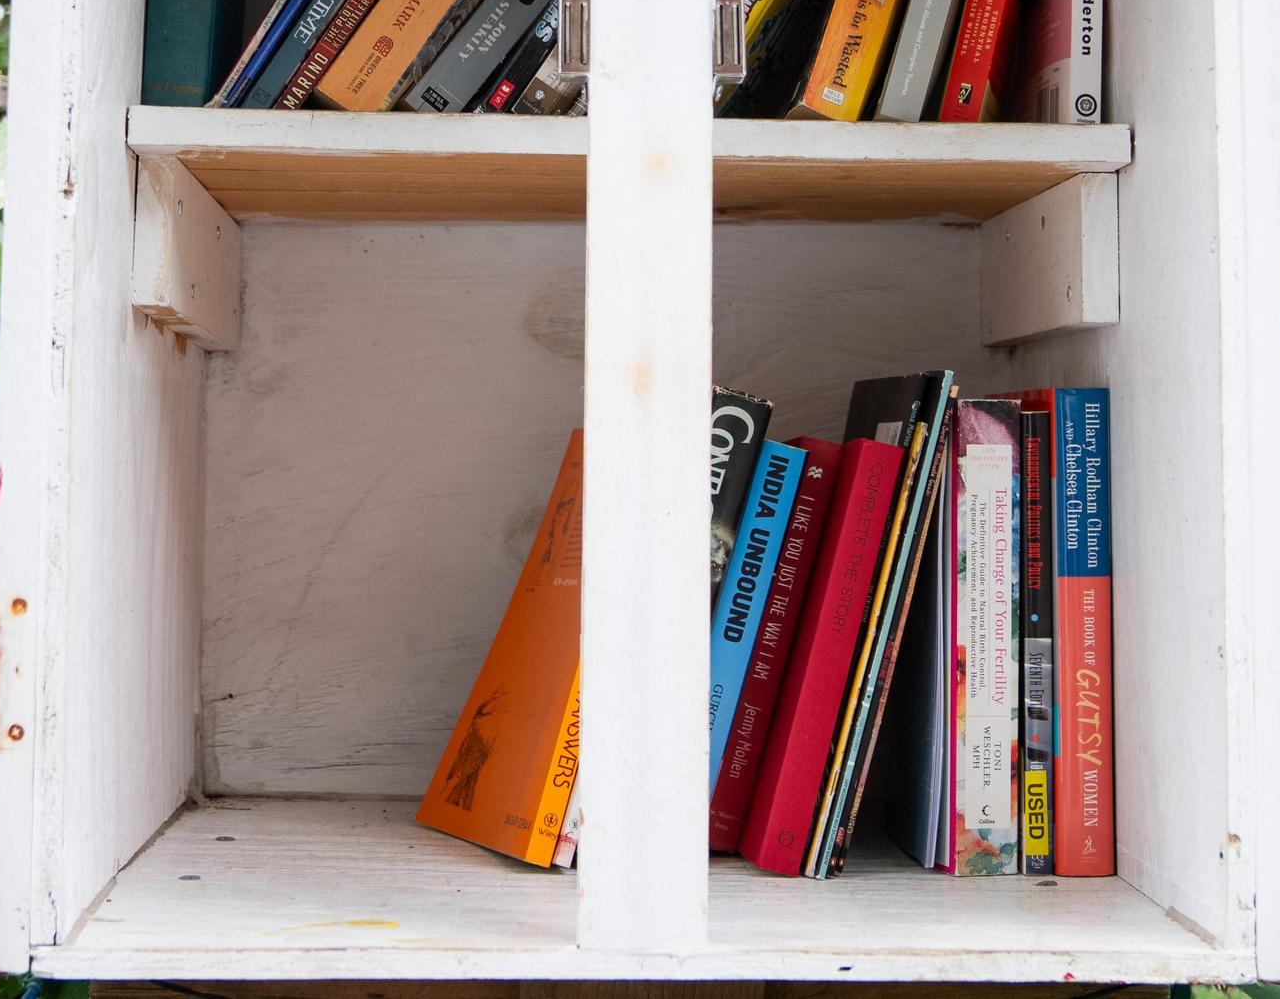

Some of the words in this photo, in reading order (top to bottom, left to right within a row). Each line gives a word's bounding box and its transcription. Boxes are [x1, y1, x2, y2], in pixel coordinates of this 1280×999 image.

[325, 28, 340, 43] THE
[336, 7, 355, 29] PLOT
[459, 0, 509, 63] STEAKLEY
[850, 11, 868, 28] for
[985, 10, 998, 50] THOMAS
[332, 28, 347, 48] KILL
[478, 20, 507, 54] JOHN
[961, 22, 973, 55] WIESEL
[366, 56, 382, 77] BEECH
[832, 34, 864, 88] Wasted
[283, 52, 329, 110] MARINO
[352, 75, 368, 96] TREE
[909, 400, 921, 424] Gianna
[1084, 402, 1101, 453] Hillary
[903, 424, 915, 447] Marino
[1065, 421, 1074, 440] AND
[755, 454, 789, 518] INDIA
[1065, 443, 1082, 497] Chelsea
[1085, 456, 1101, 515] Rodham
[792, 505, 813, 532] LIKE
[853, 463, 883, 547] COMPLETE
[970, 494, 978, 536] Pregnancy
[979, 503, 987, 514] The
[993, 488, 1008, 532] Taking
[979, 516, 987, 559] Definitive
[1067, 499, 1083, 550] Clinton
[784, 534, 804, 561] YOU
[1087, 518, 1102, 568] Clinton
[777, 563, 797, 591] JUST
[844, 554, 863, 582] THE
[979, 562, 987, 587] Guide
[993, 537, 1008, 586] Charge
[723, 528, 770, 643] UNBOUND
[980, 589, 986, 598] to
[995, 590, 1008, 605] of
[1083, 589, 1095, 612] THE
[769, 595, 789, 618] THE
[833, 587, 855, 636] STORY
[979, 600, 987, 631] Natural
[762, 622, 783, 649] WAY
[970, 615, 978, 664] Reproductive
[994, 607, 1008, 642] Your
[1083, 615, 1096, 646] BOOK
[753, 660, 771, 680] AM
[1083, 650, 1096, 666] OF
[992, 647, 1007, 705] Fertility
[737, 703, 762, 738] Jenny
[1075, 668, 1103, 766] GUTSY
[729, 741, 752, 778] Mollen
[972, 746, 980, 770] MPH
[993, 742, 1002, 772] TONI
[1027, 783, 1044, 840] USED
[1083, 768, 1099, 827] WOMEN
[538, 827, 558, 840] Wiley
